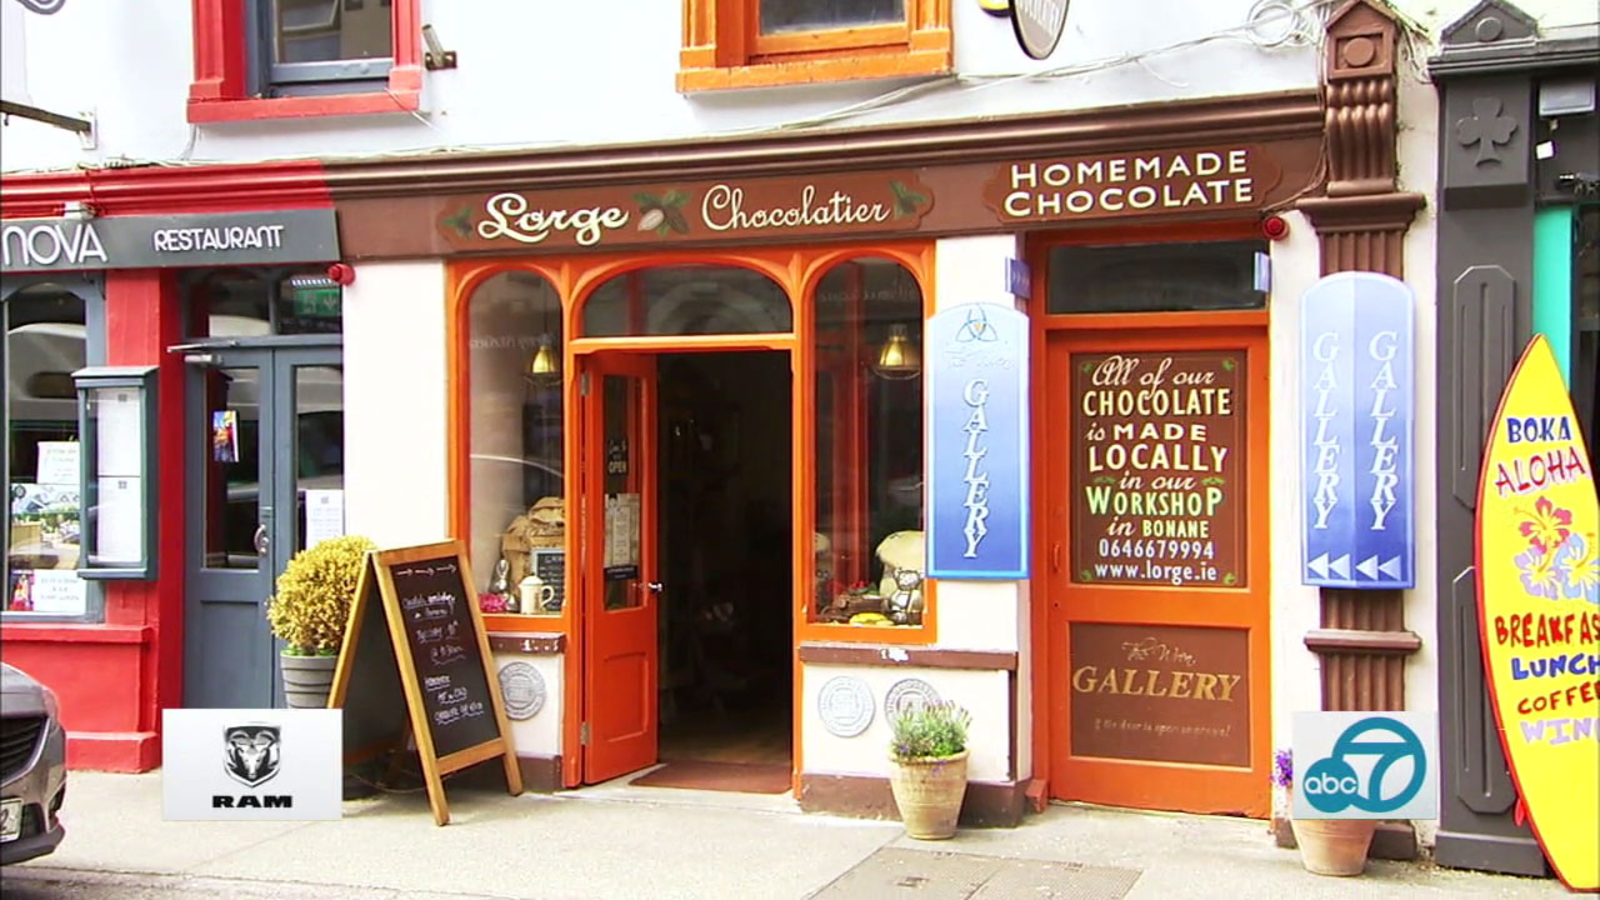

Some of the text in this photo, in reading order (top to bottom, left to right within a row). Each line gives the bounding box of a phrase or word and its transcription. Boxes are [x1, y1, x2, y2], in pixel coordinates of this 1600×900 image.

[1011, 150, 1247, 189] HOMEMADE
[1004, 178, 1252, 216] CHOCOLATE
[478, 184, 891, 245] Lorge Chocolatier
[1, 223, 284, 265] NOVA RESTAURANT
[1092, 355, 1215, 400] All of our
[1083, 388, 1231, 416] CHOCOLATE
[1085, 422, 1207, 442] is MADE
[1312, 332, 1341, 530] GALLERY
[1369, 331, 1398, 530] GALLERY
[1507, 416, 1571, 443] BOKA
[962, 379, 990, 558] GALLERY
[1088, 444, 1228, 472] LOCALLY
[1495, 446, 1586, 495] ALOHA
[1119, 471, 1197, 490] in our
[1085, 486, 1223, 516] WORKSHOP
[1107, 516, 1209, 538] in BONANE
[1099, 538, 1214, 559] 0646679994
[1094, 560, 1217, 586] www.lorge.ie
[1072, 665, 1241, 702] GALLERY
[1520, 717, 1600, 745] WIN
